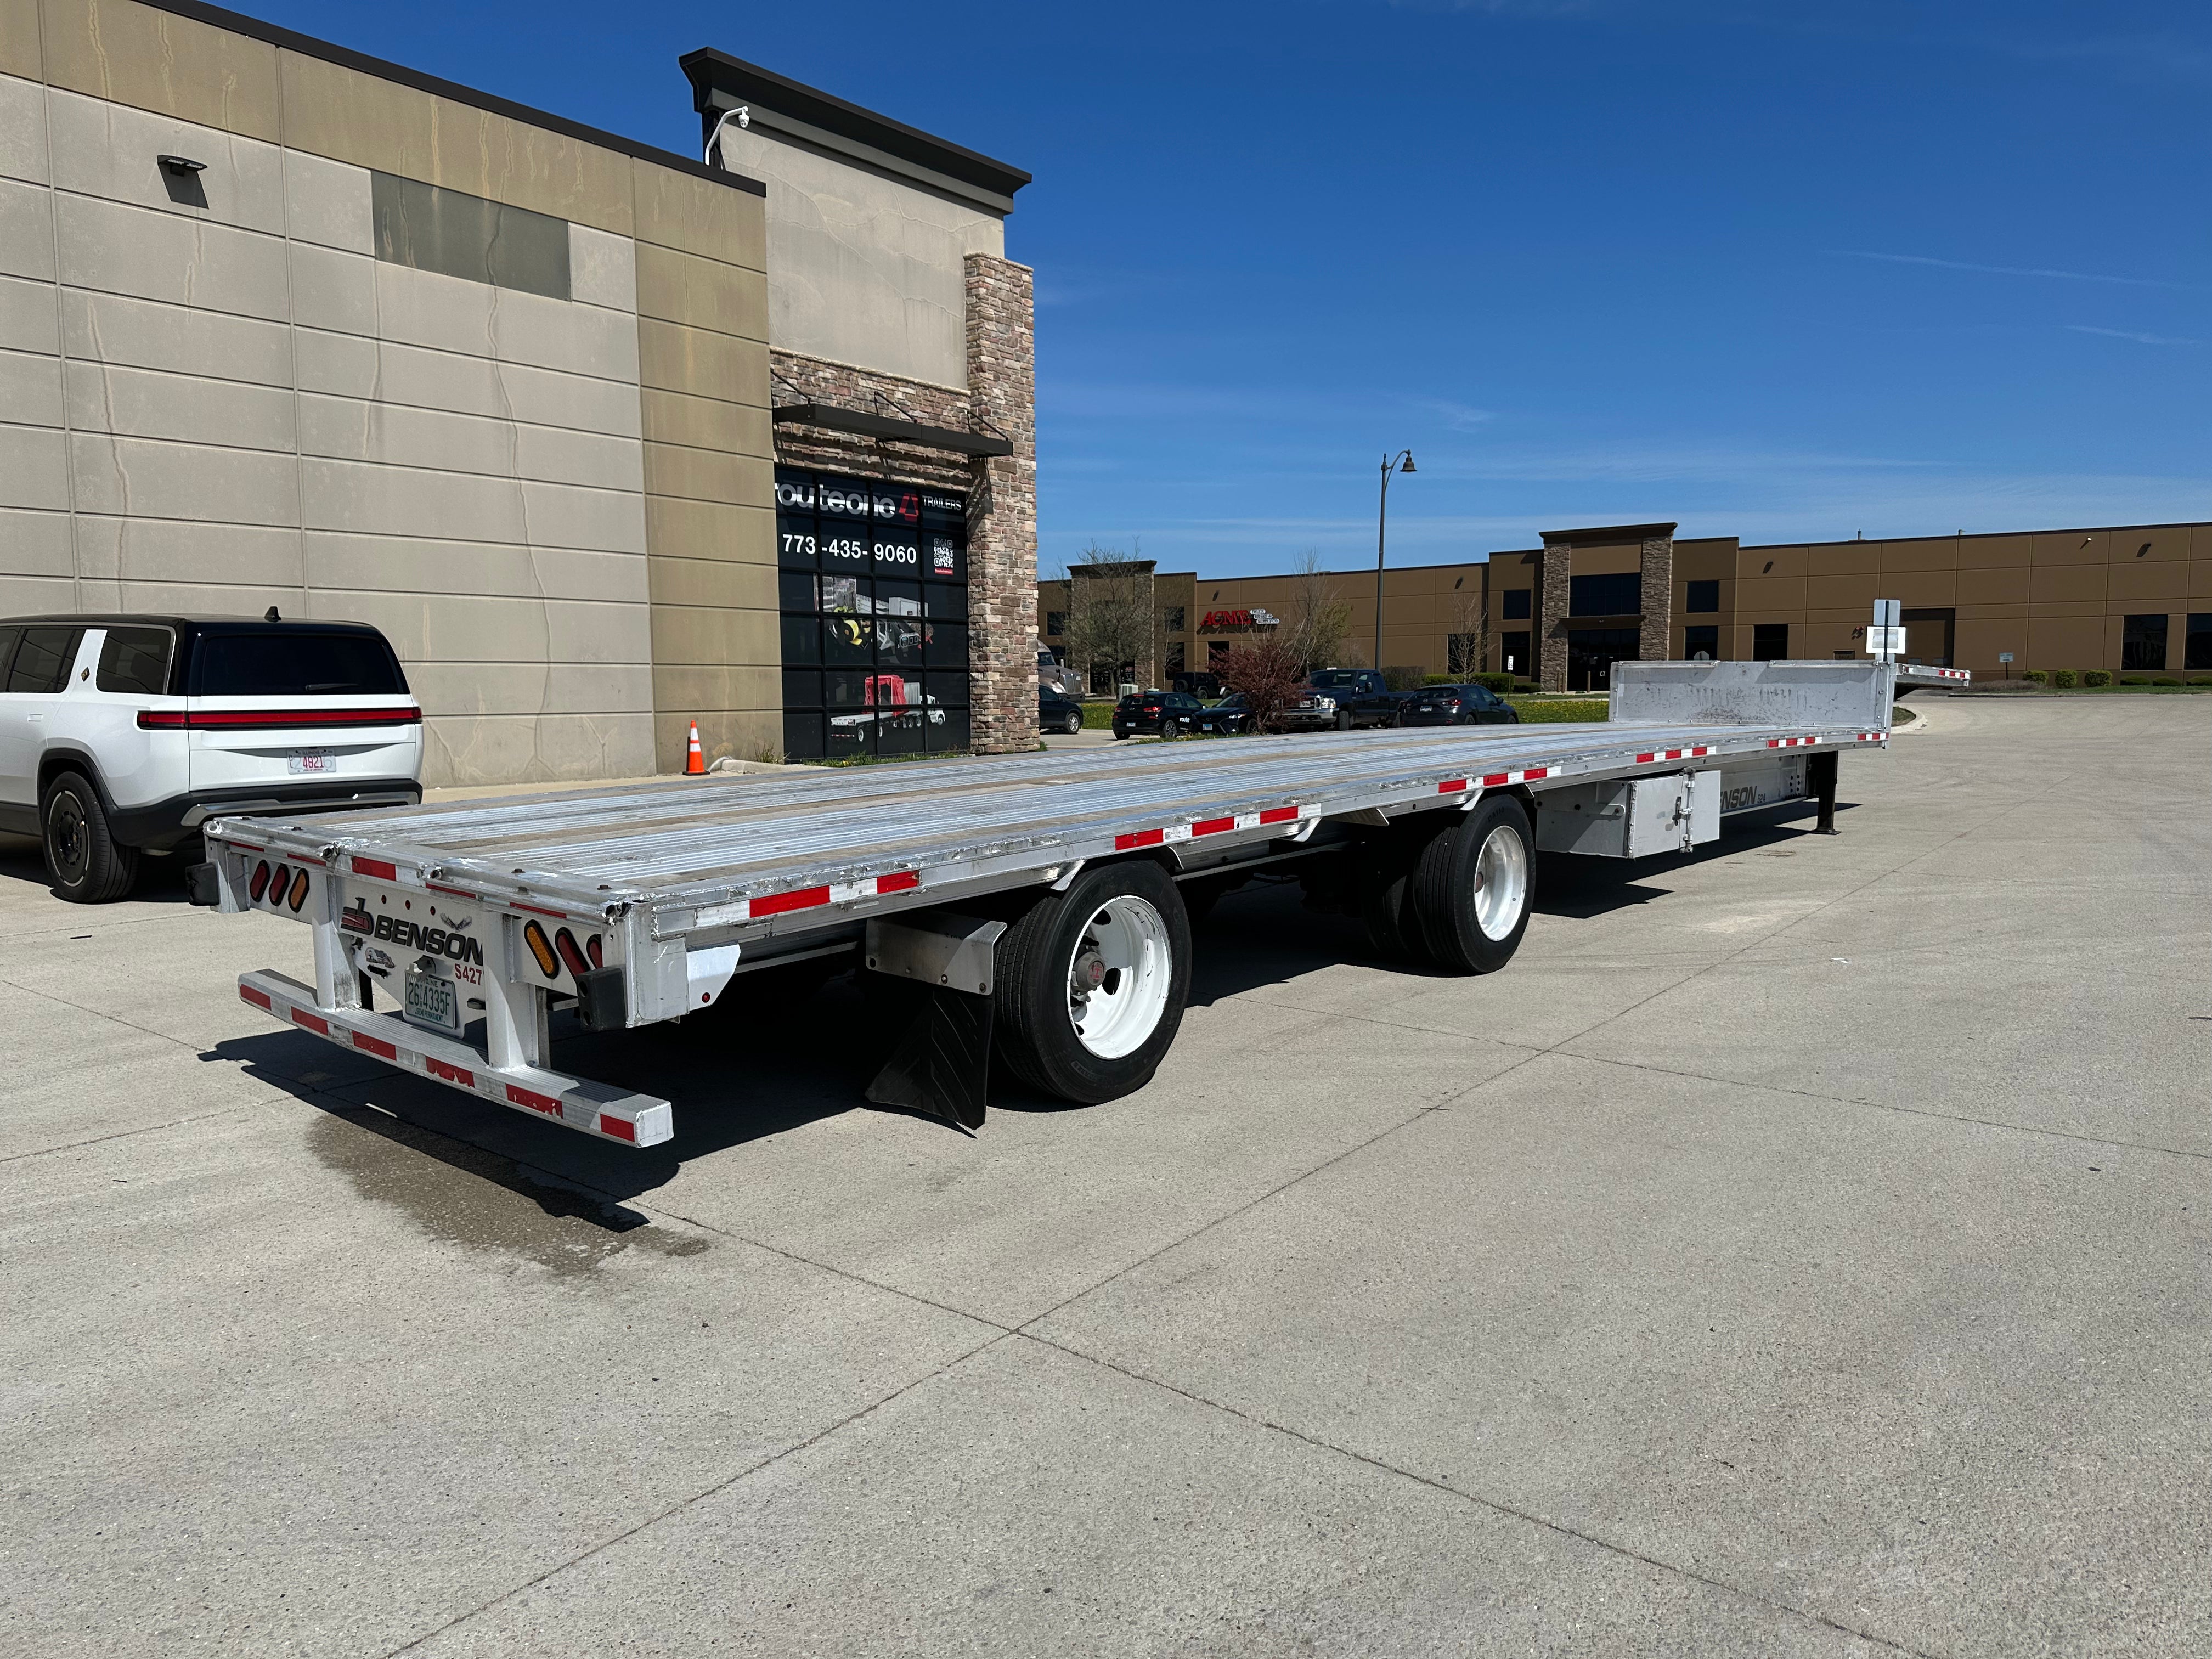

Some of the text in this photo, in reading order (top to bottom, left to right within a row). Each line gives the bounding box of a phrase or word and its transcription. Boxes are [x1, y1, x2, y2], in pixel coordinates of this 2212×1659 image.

[922, 495, 961, 511] TRAILERS
[1200, 610, 1251, 625] ACME
[303, 756, 324, 768] 4821
[374, 915, 483, 966] BENSON
